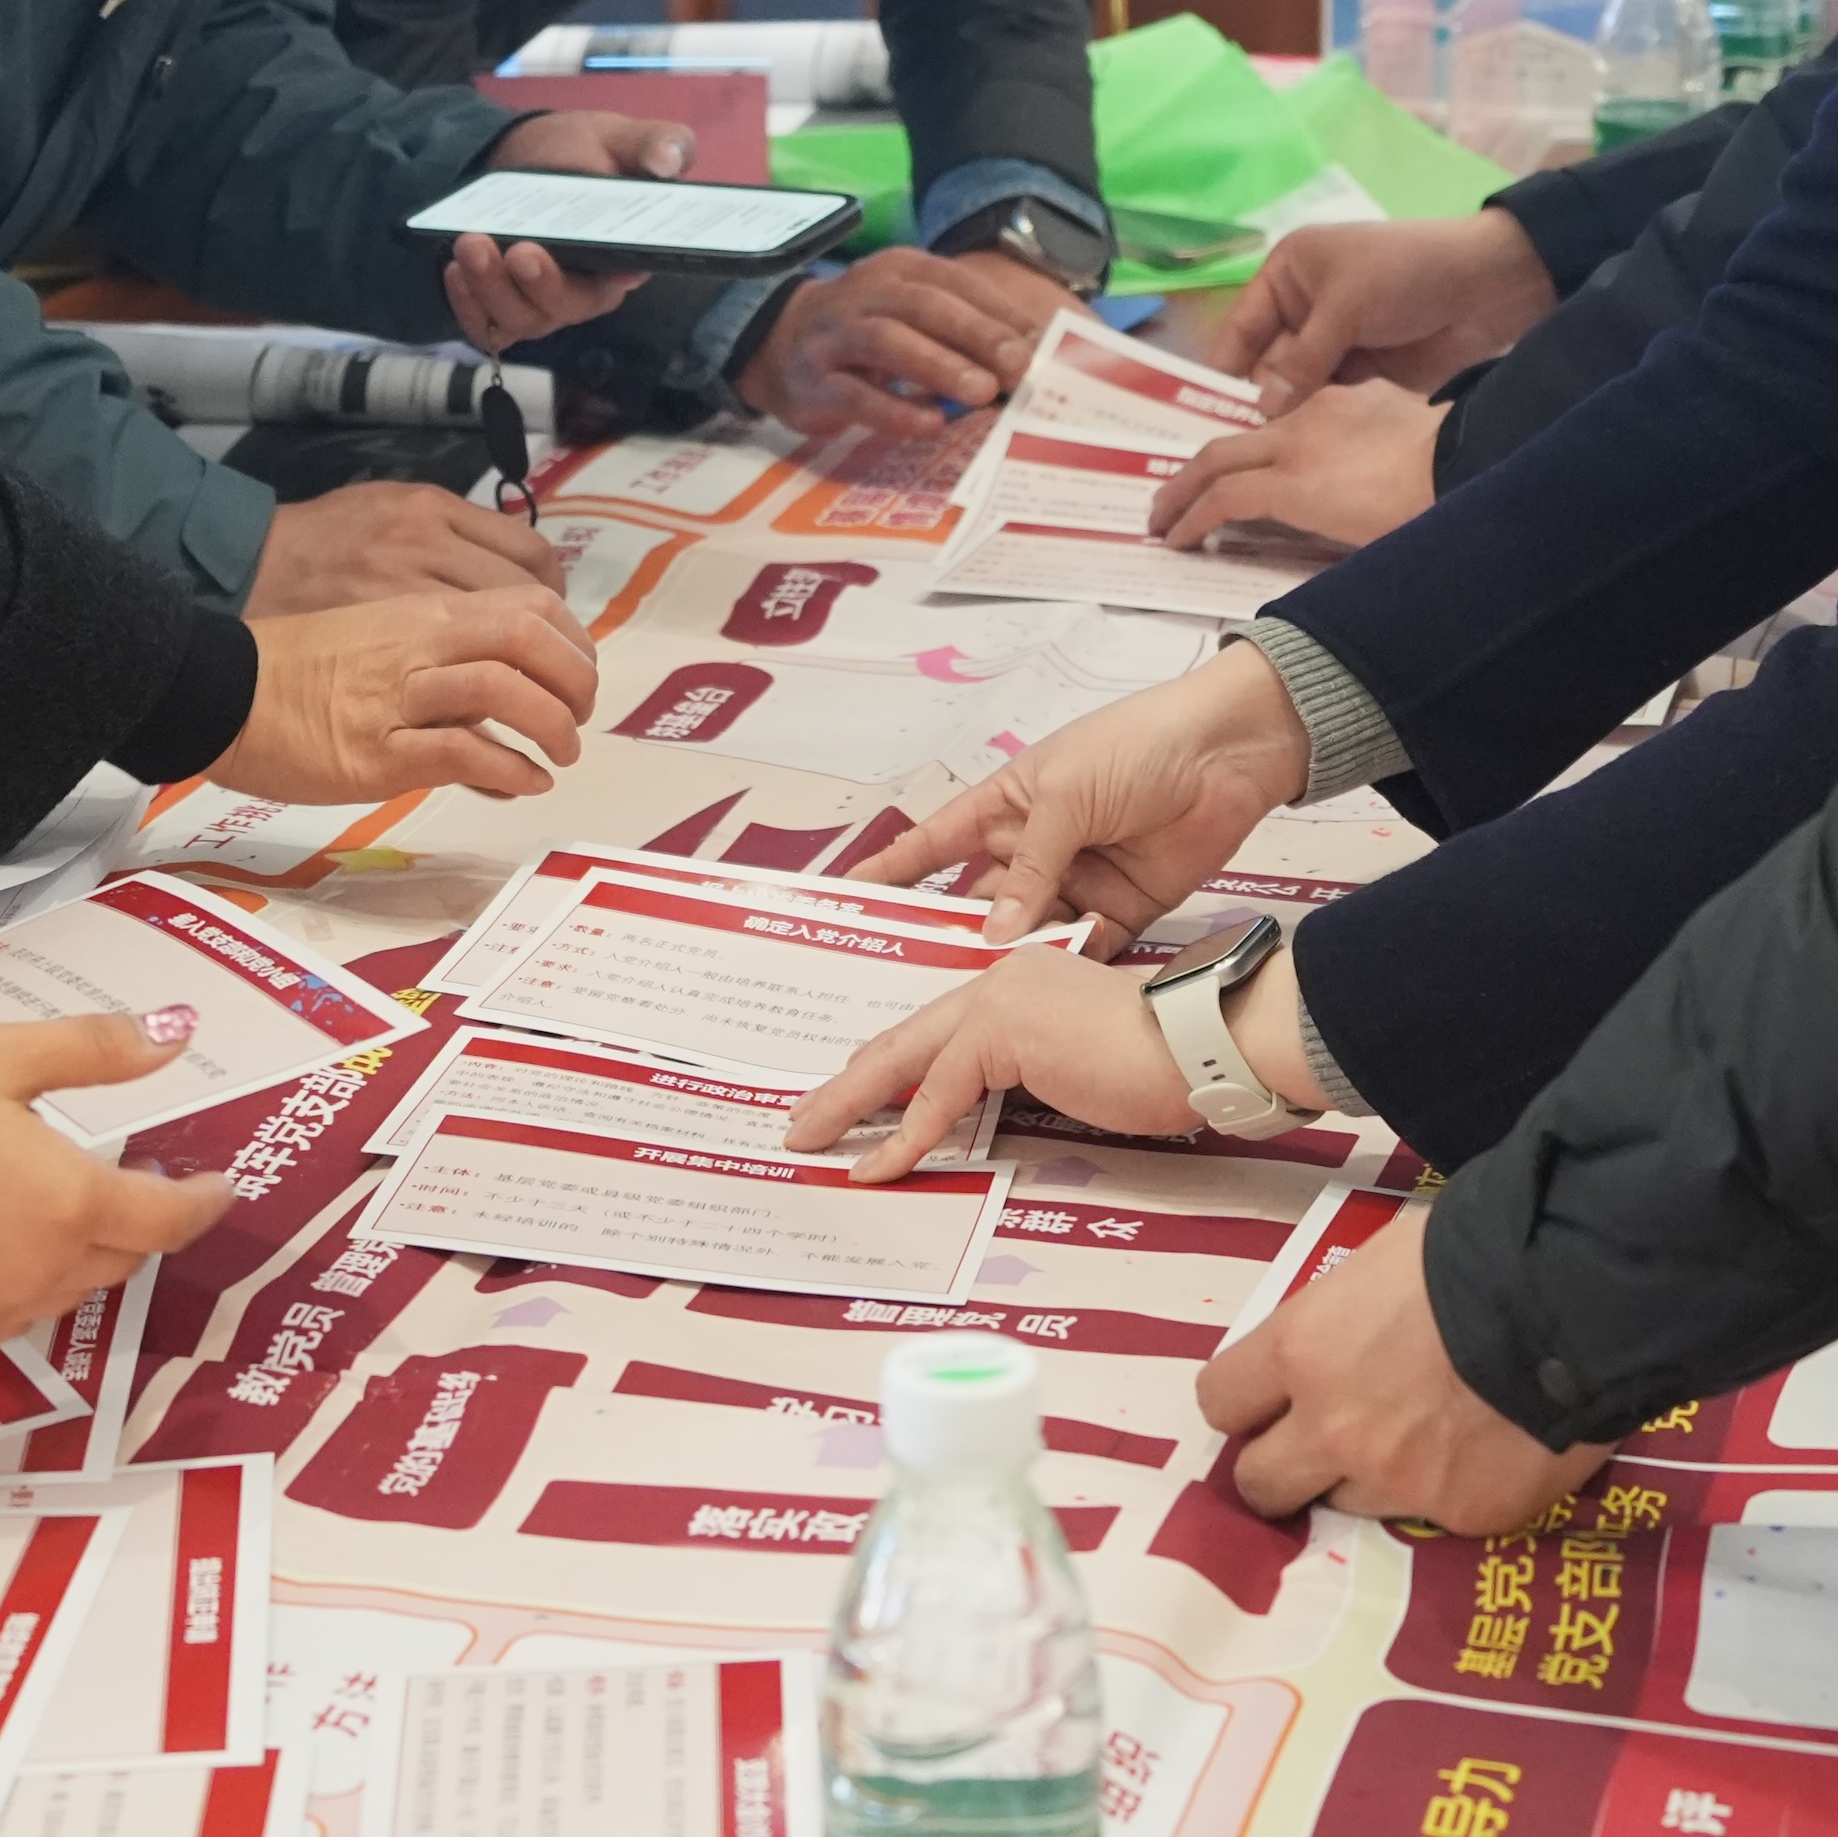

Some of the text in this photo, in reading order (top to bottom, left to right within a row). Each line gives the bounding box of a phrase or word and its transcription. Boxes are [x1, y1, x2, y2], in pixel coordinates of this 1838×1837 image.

[743, 915, 905, 957] 确定入党介绍人
[633, 1147, 795, 1179] 开展集中培训
[841, 1299, 1080, 1340] 管理党员
